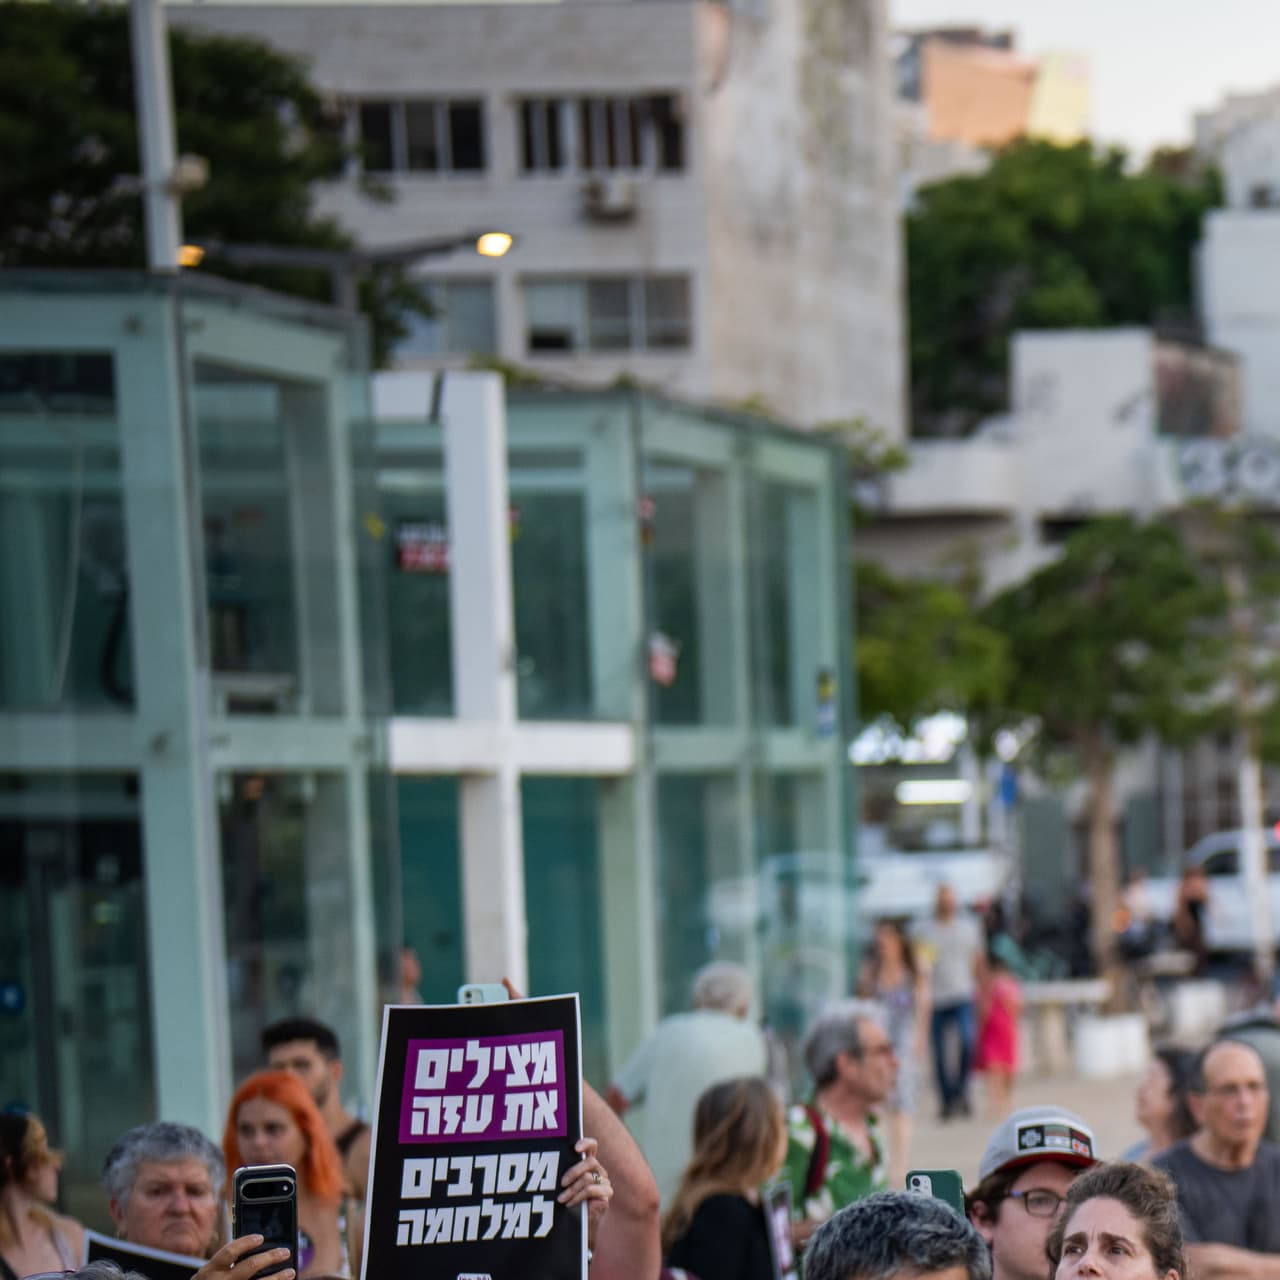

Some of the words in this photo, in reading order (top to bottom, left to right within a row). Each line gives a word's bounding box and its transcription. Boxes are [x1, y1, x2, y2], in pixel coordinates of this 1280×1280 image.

[413, 1039, 557, 1090] מצילים
[410, 1094, 494, 1136] עזה
[501, 1089, 559, 1133] את
[400, 1150, 561, 1200] מסרבים
[396, 1194, 555, 1247] למלחמה
